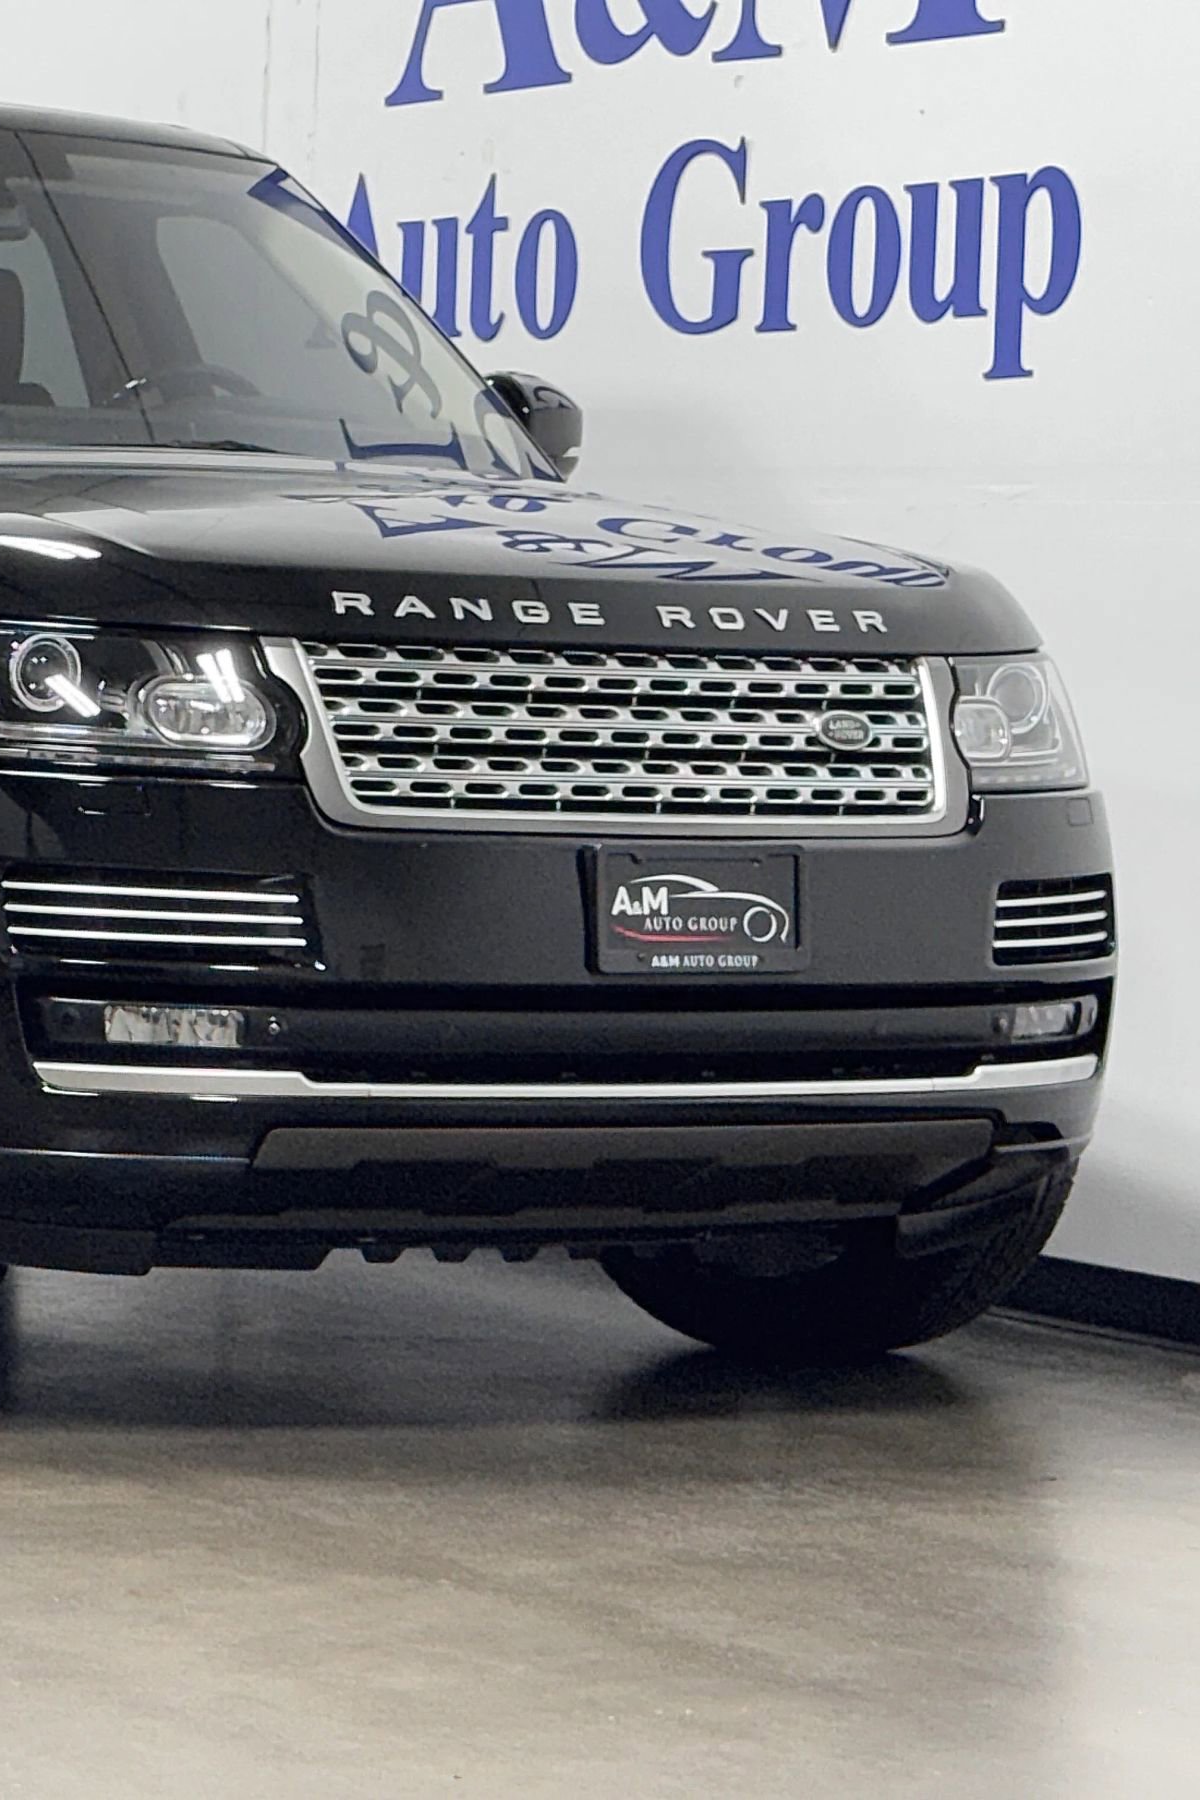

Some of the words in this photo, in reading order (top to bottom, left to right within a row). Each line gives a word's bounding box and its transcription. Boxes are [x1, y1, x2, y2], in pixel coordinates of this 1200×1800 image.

[640, 137, 1083, 380] Group
[331, 590, 606, 625] RANGE
[655, 605, 888, 633] ROVER
[611, 886, 669, 916] A&M
[644, 916, 683, 931] AUTO
[687, 916, 738, 931] GROUP
[682, 955, 714, 968] AUTO
[717, 955, 760, 968] GROUP
